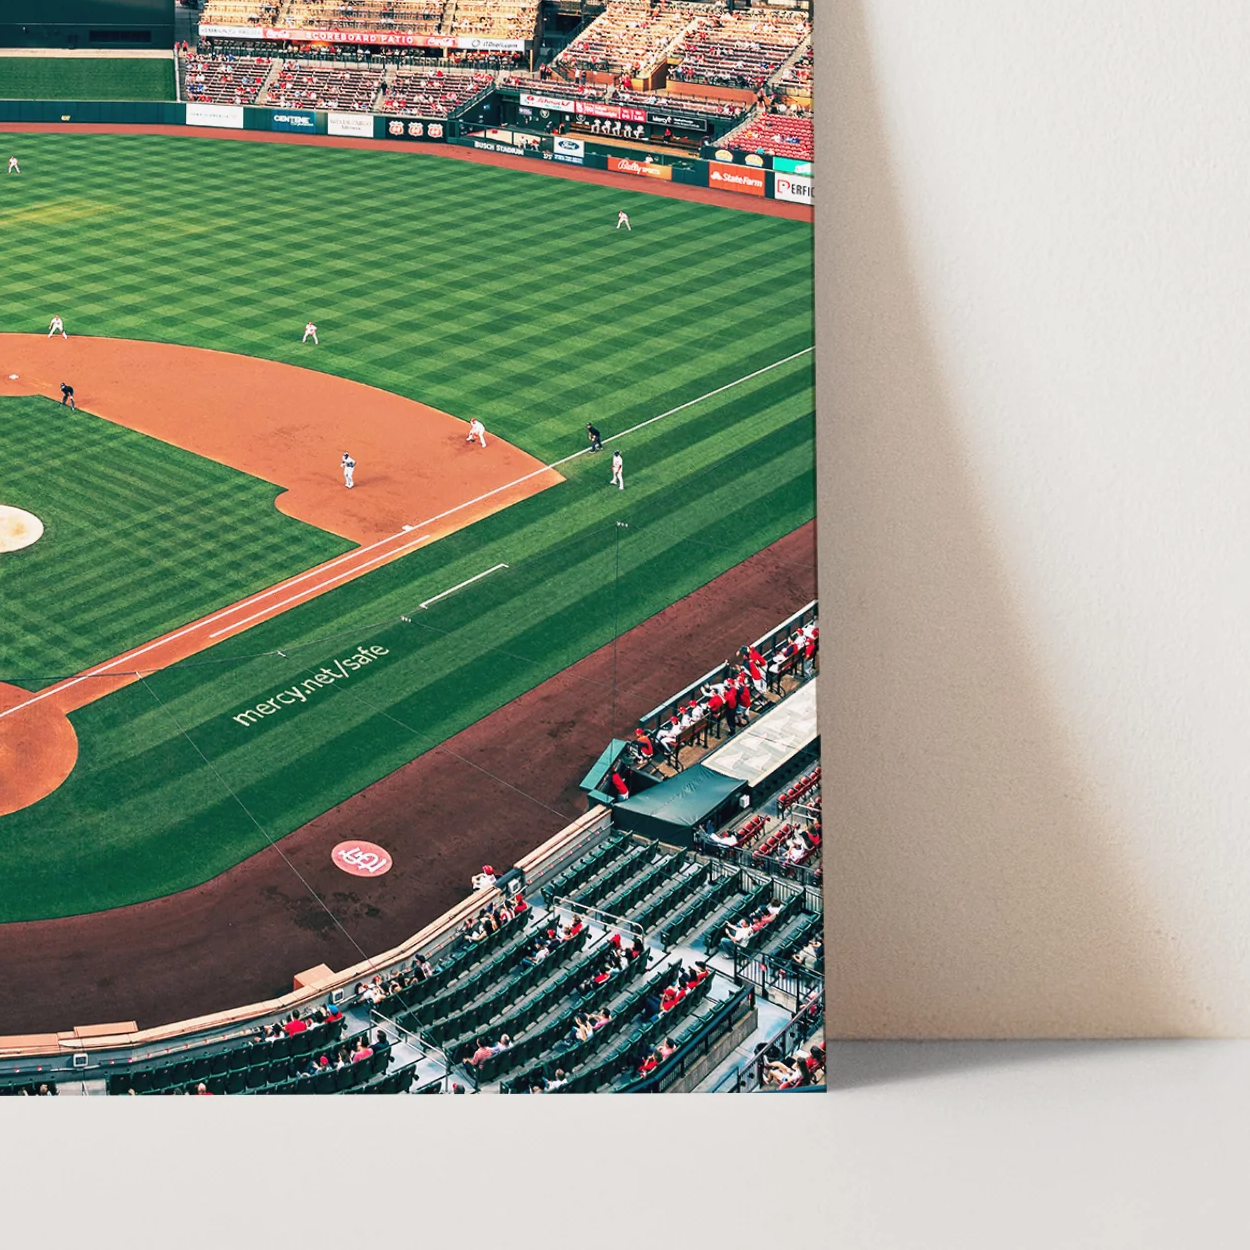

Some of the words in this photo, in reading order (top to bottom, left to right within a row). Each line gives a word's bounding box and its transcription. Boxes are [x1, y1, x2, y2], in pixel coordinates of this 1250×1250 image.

[305, 32, 376, 43] SCOREBOARD
[381, 36, 414, 44] PATIO
[474, 141, 495, 151] BUSCH
[495, 144, 524, 155] STADIUM
[618, 159, 641, 174] Bally
[233, 645, 390, 726] mercy.net/safe
